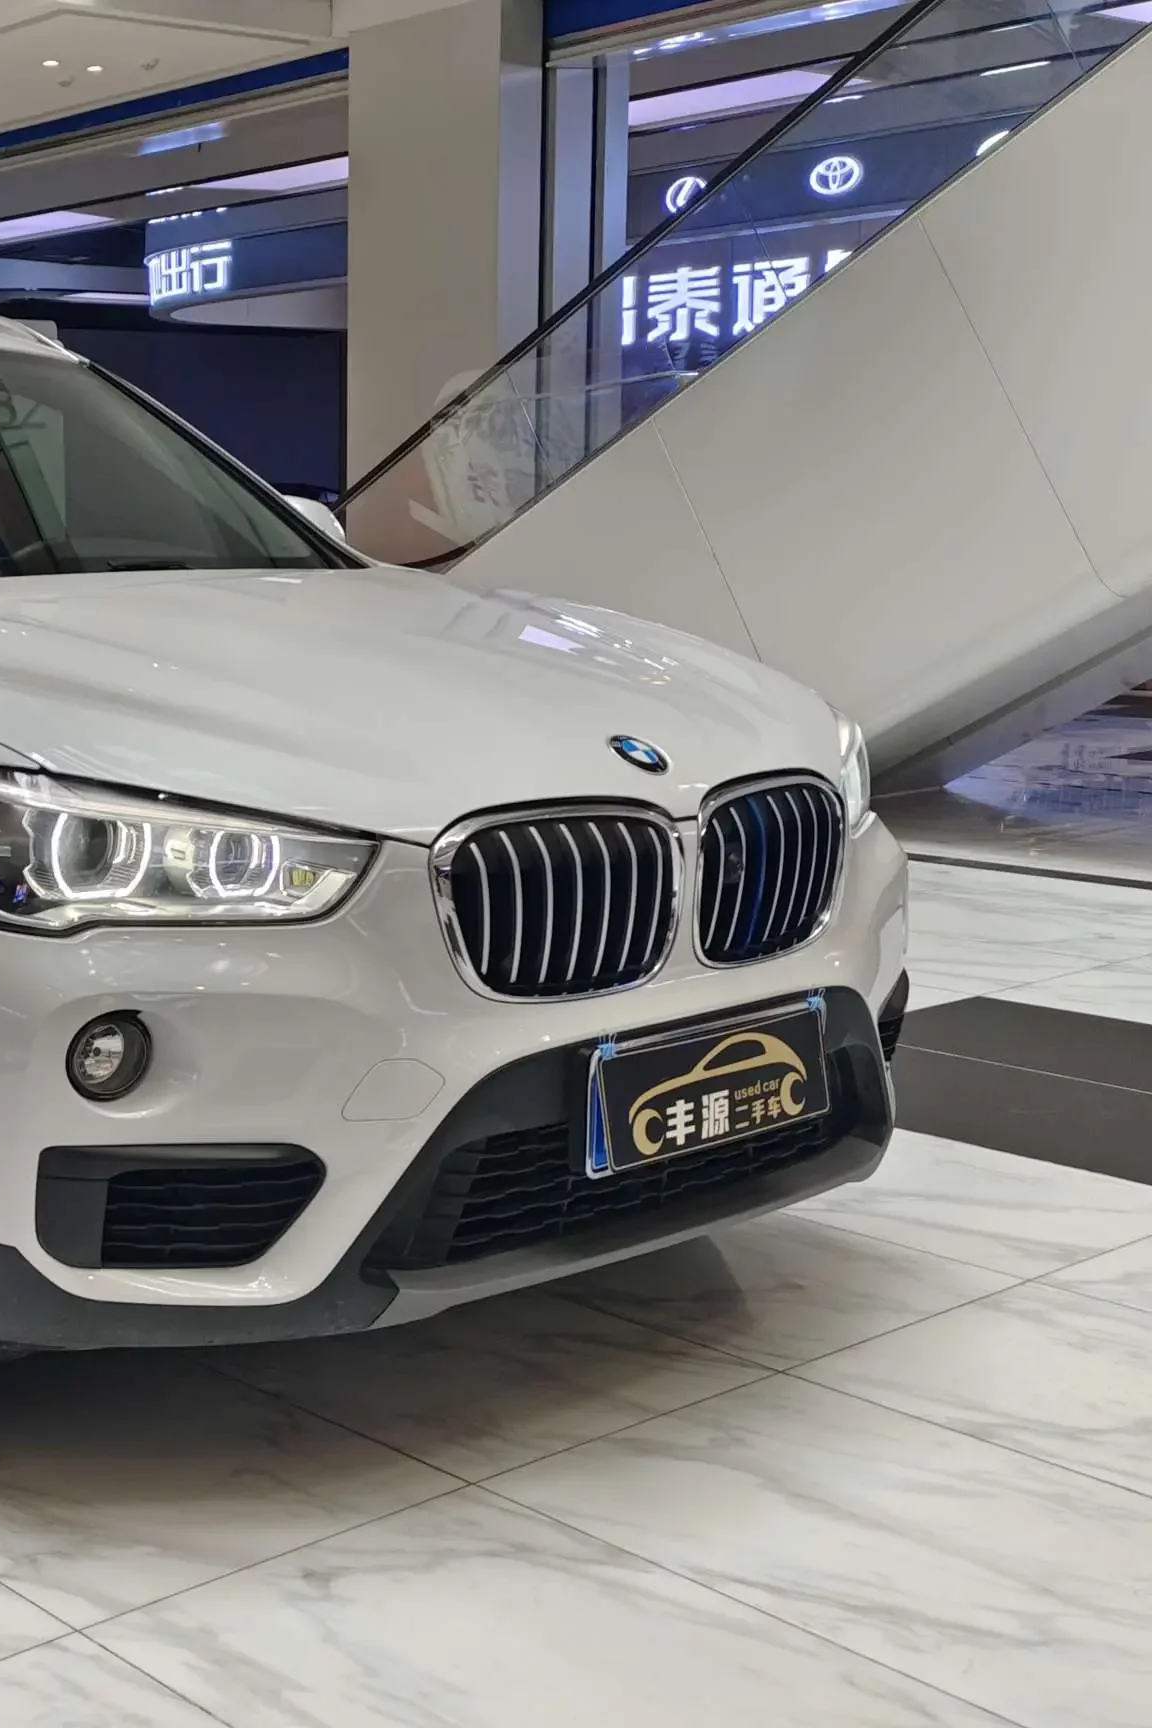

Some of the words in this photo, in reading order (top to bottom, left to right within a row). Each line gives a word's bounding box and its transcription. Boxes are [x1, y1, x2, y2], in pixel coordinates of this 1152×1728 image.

[621, 249, 852, 346] 泰通
[665, 1089, 730, 1146] 丰源
[735, 1095, 782, 1129] 二手车
[734, 1079, 761, 1100] used
[762, 1078, 781, 1093] car
